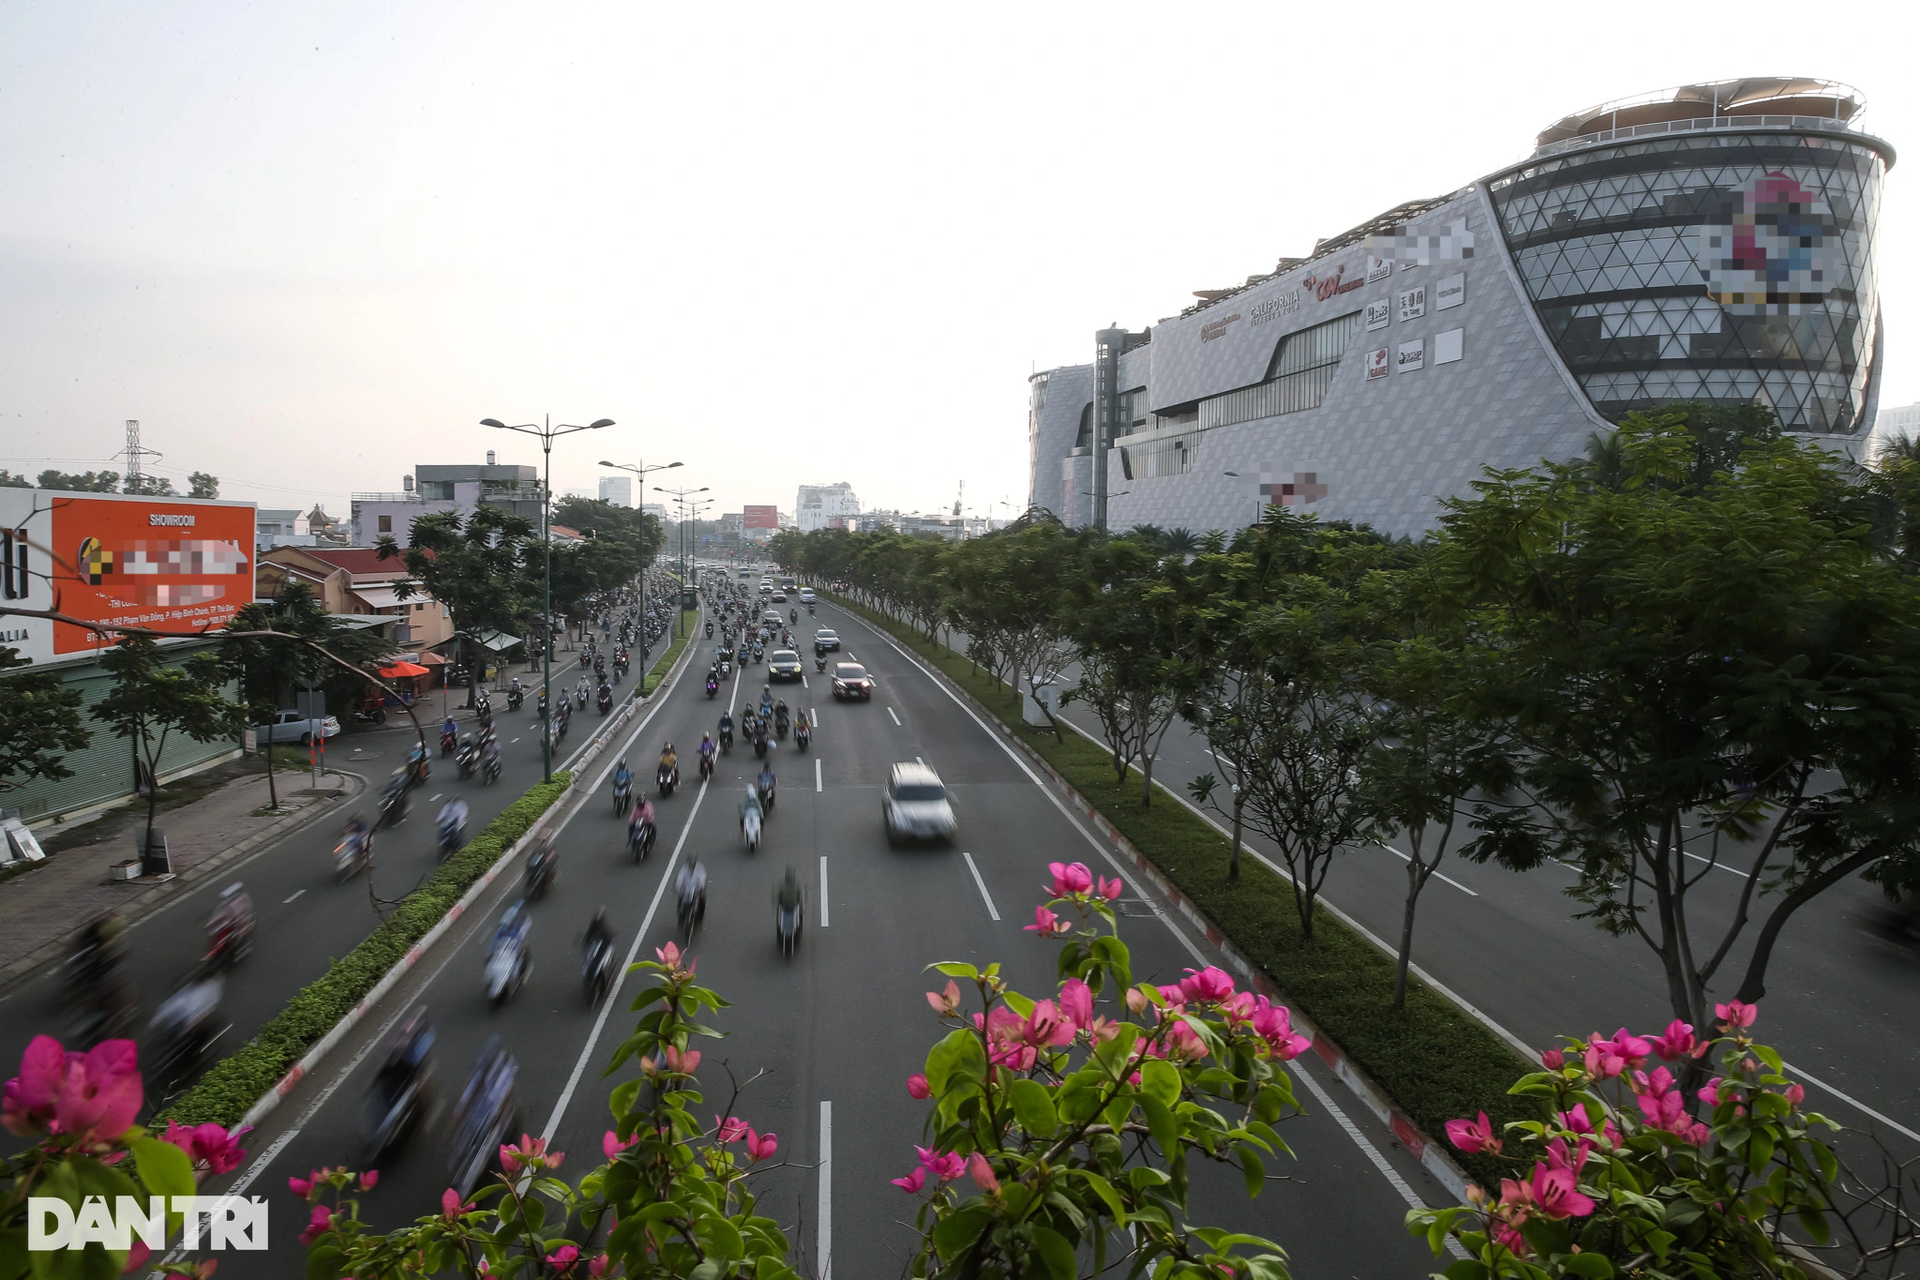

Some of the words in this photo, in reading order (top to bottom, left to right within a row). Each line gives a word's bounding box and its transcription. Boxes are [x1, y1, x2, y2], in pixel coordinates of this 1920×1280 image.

[1250, 289, 1300, 320] CALIFORNIA
[1282, 303, 1300, 316] YOGA
[149, 513, 196, 527] SHOWROOM
